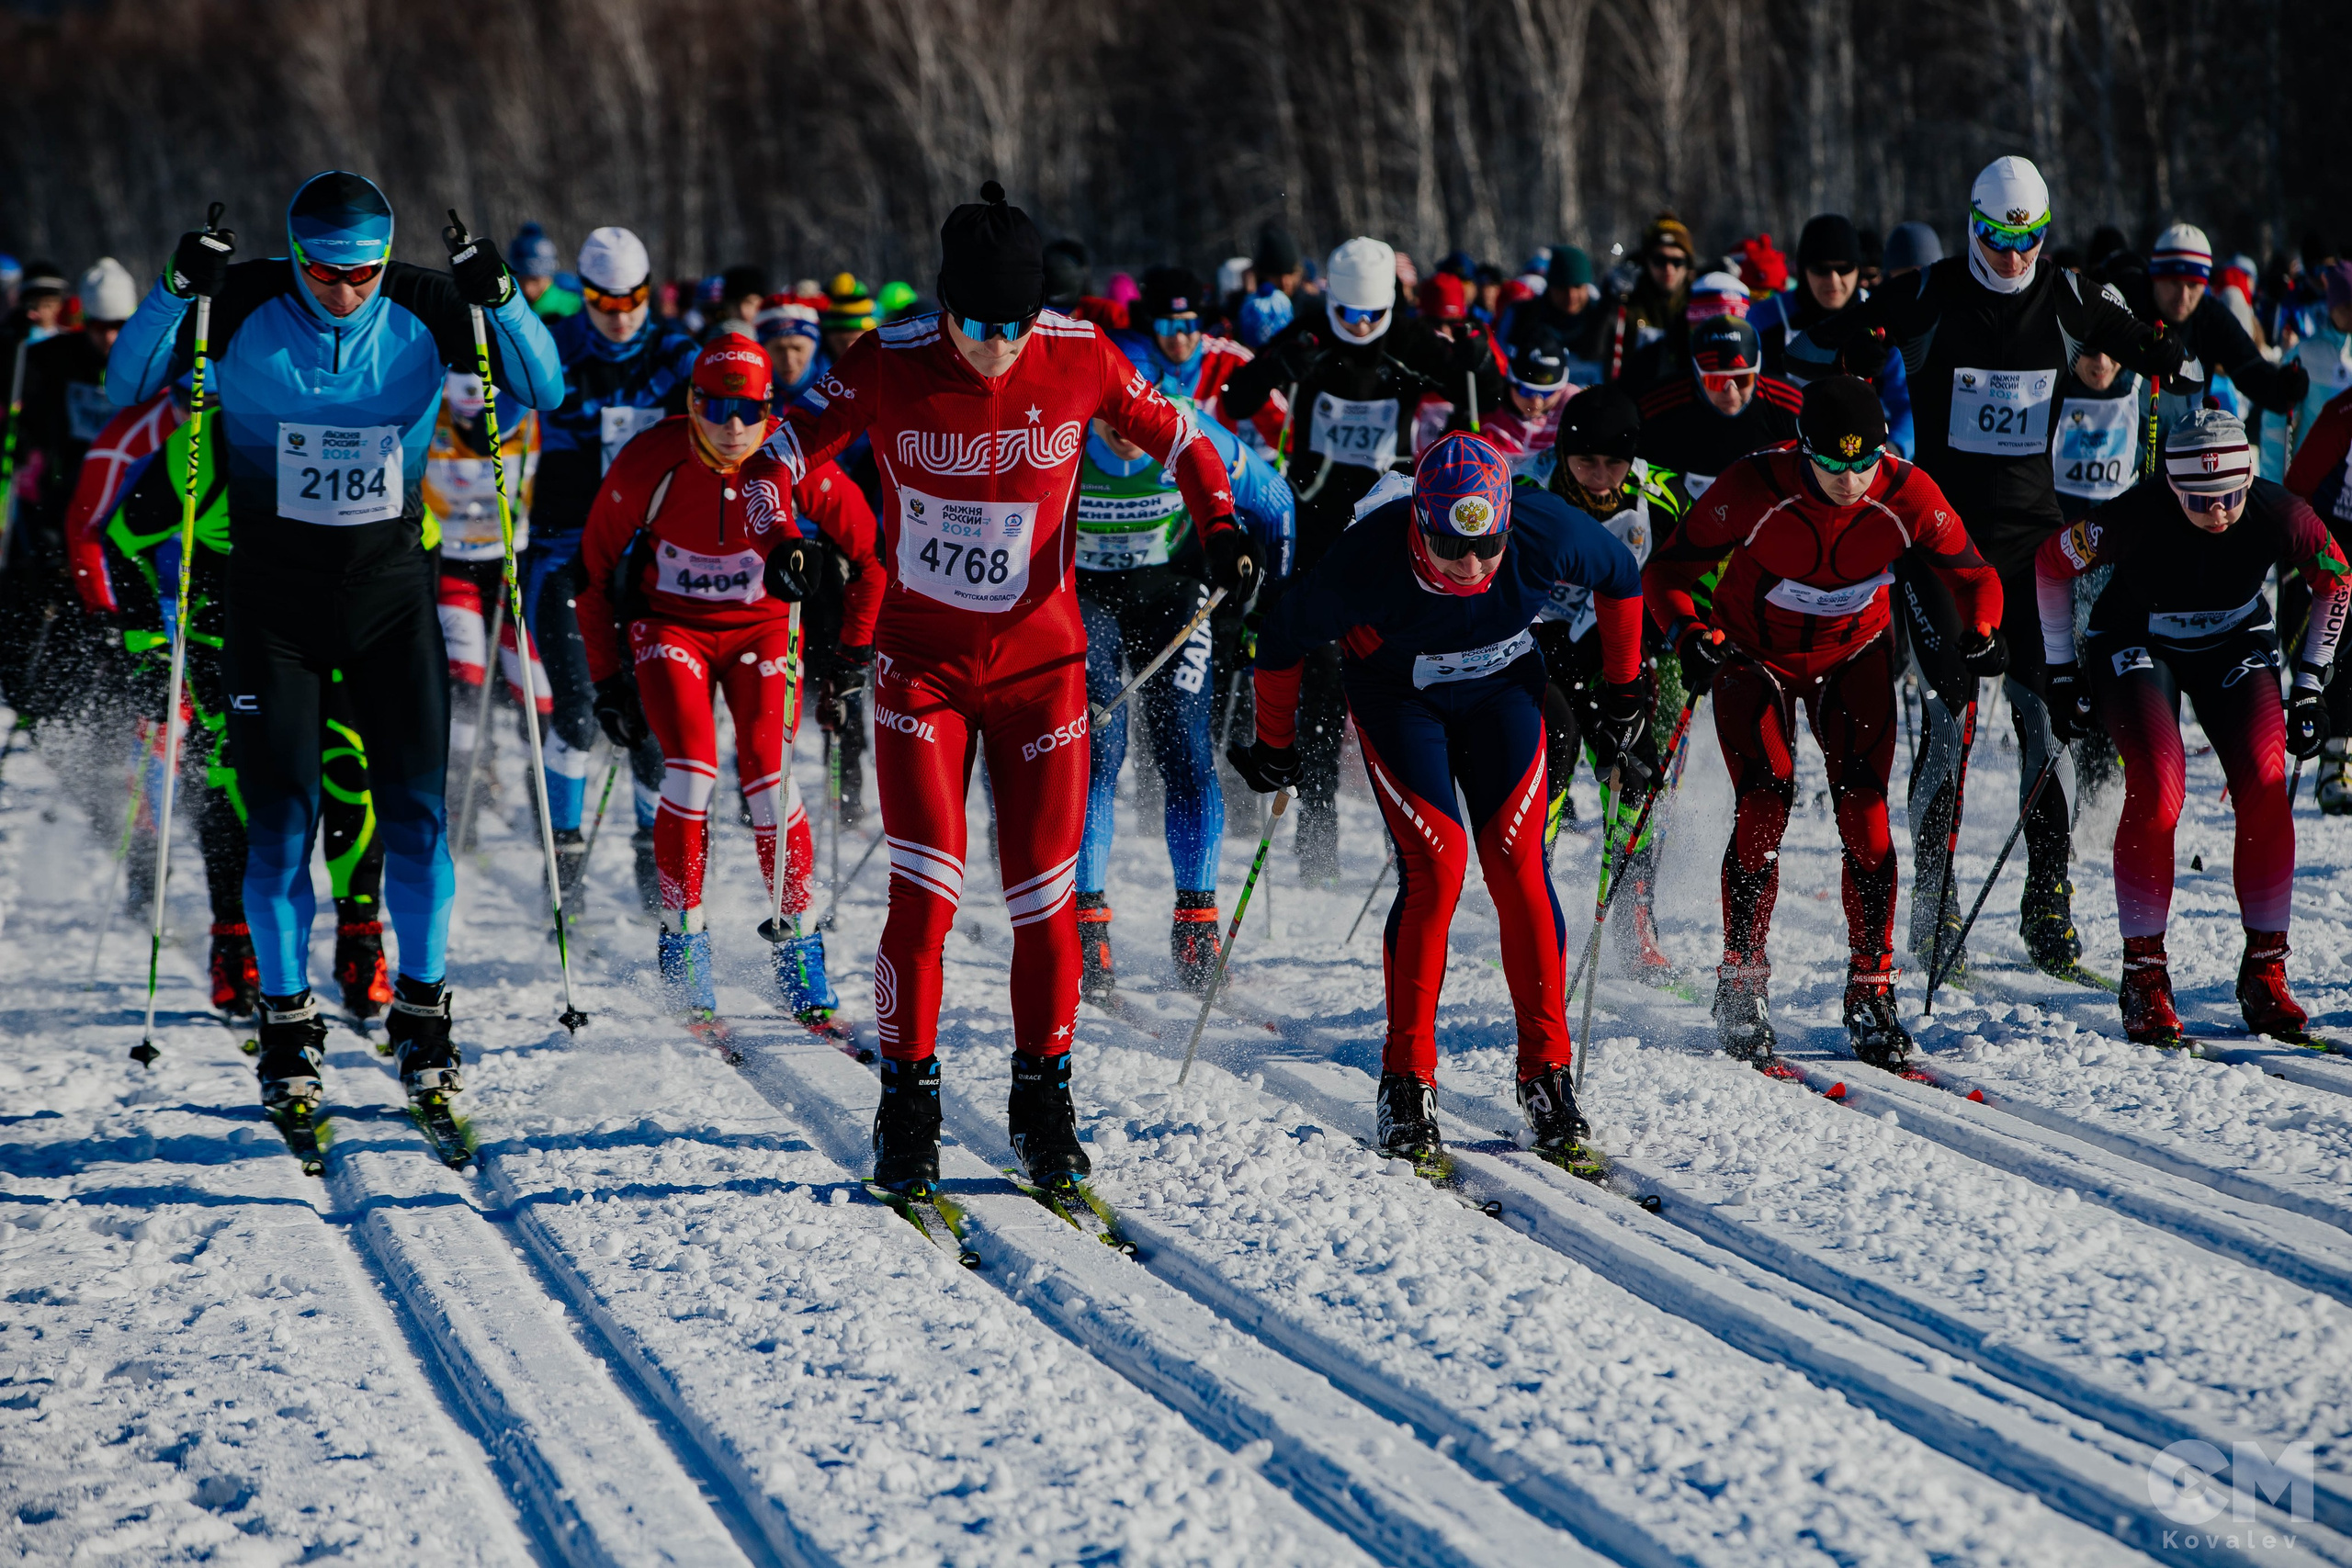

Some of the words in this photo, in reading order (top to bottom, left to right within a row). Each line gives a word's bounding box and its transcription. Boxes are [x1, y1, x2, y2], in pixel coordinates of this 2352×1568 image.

[704, 350, 765, 368] МОСКВА
[1989, 389, 2018, 400] 2024
[1978, 403, 2028, 434] 621
[322, 431, 361, 439] ЛЫЖНЯ
[1326, 424, 1385, 450] 4737
[322, 439, 361, 447] РОССИИ
[322, 449, 361, 460] 2024
[2065, 460, 2121, 482] 400
[300, 467, 387, 501] 2184
[942, 504, 983, 516] ЛЫЖНЯ
[1080, 497, 1161, 509] МАРАФОН
[942, 511, 982, 525] РОССИИ
[941, 522, 982, 537] 2024
[920, 536, 1010, 584] 4768
[677, 568, 751, 593] 4404
[954, 589, 989, 602] ИРКУТСКАЯ
[989, 591, 1017, 602] ОБЛАСТЬ
[1905, 581, 1935, 634] CRAFT
[1462, 646, 1499, 659] РОССИИ
[635, 643, 703, 680] LUKOIL
[875, 704, 935, 743] LUKOIL
[1021, 716, 1086, 761] BOSCO
[2251, 947, 2283, 958] alpina
[2137, 955, 2167, 966] alpina
[401, 1005, 439, 1015] salomon
